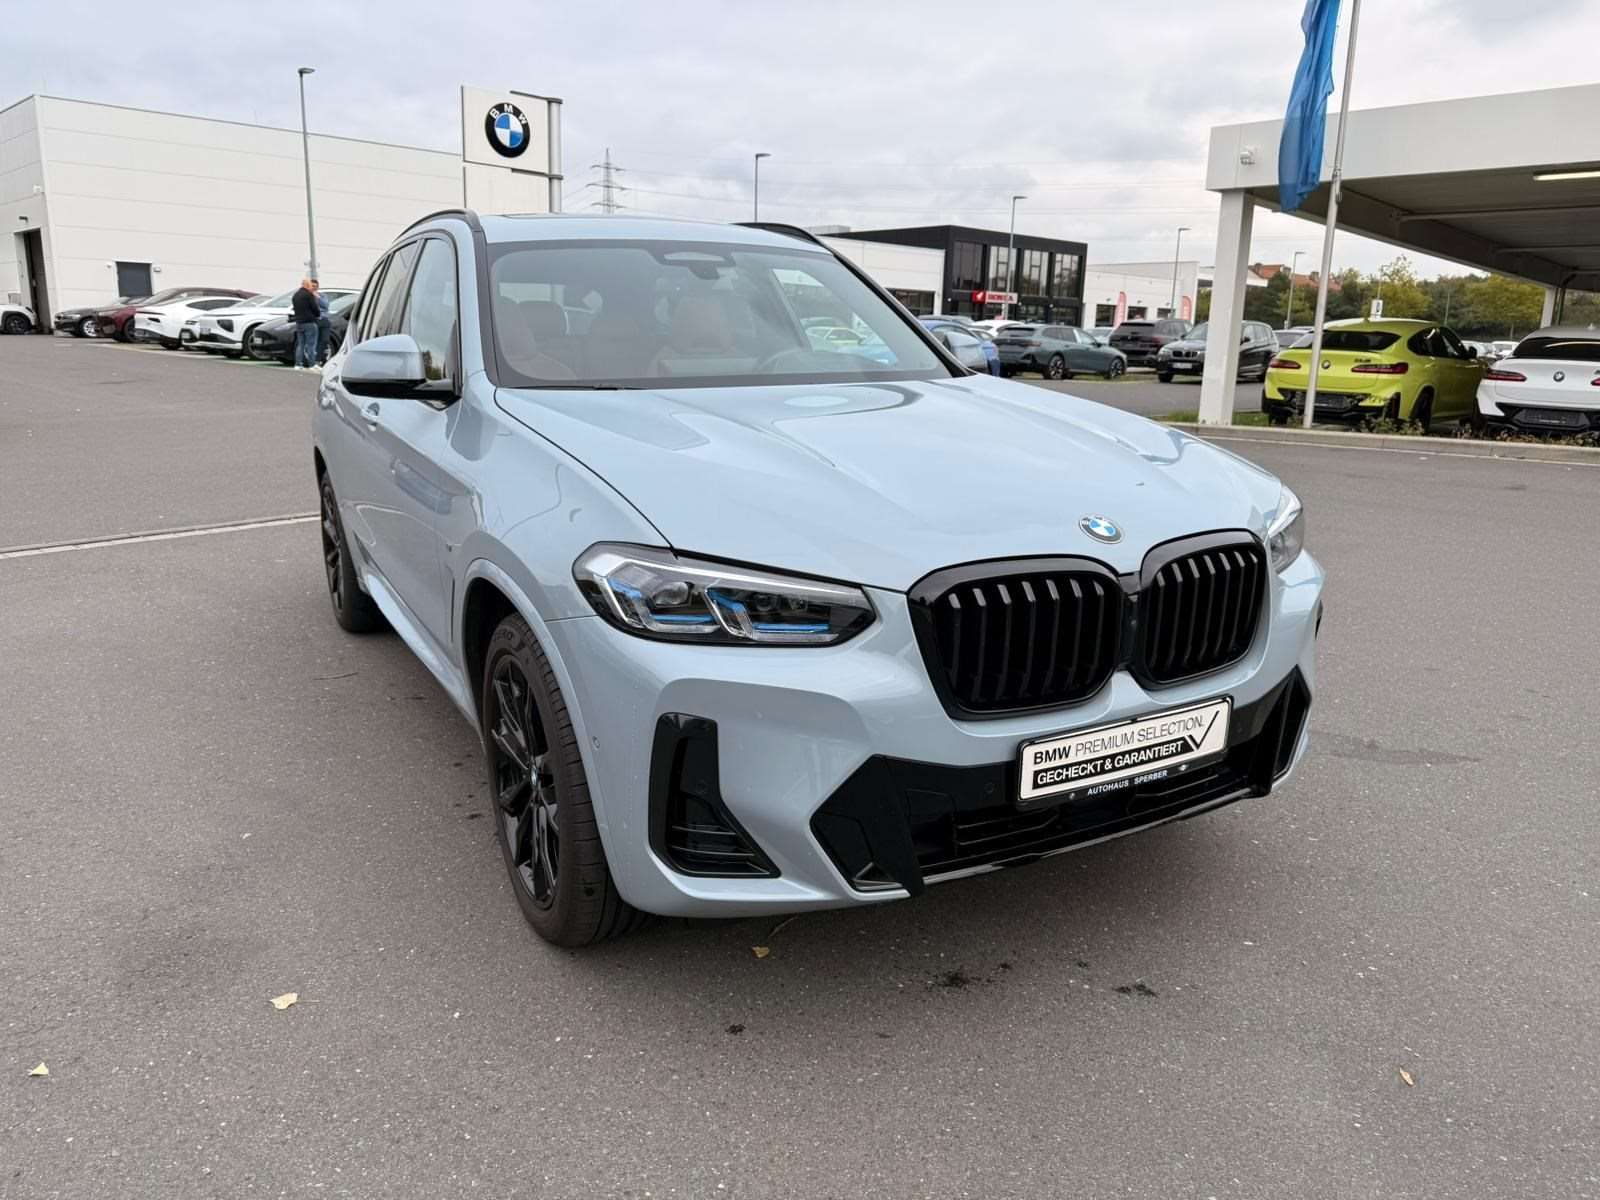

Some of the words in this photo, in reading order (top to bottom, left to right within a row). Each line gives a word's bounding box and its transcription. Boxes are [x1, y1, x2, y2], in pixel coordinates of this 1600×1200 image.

[490, 104, 528, 124] BMW
[1034, 745, 1072, 765] BMW
[1075, 731, 1135, 757] PREMIUM
[1037, 760, 1104, 785] GECHECKT
[1104, 758, 1113, 770] &
[1114, 741, 1184, 767] GARANTIERT
[1087, 779, 1129, 796] AUTOHAUS
[1134, 770, 1168, 785] SPERBER
